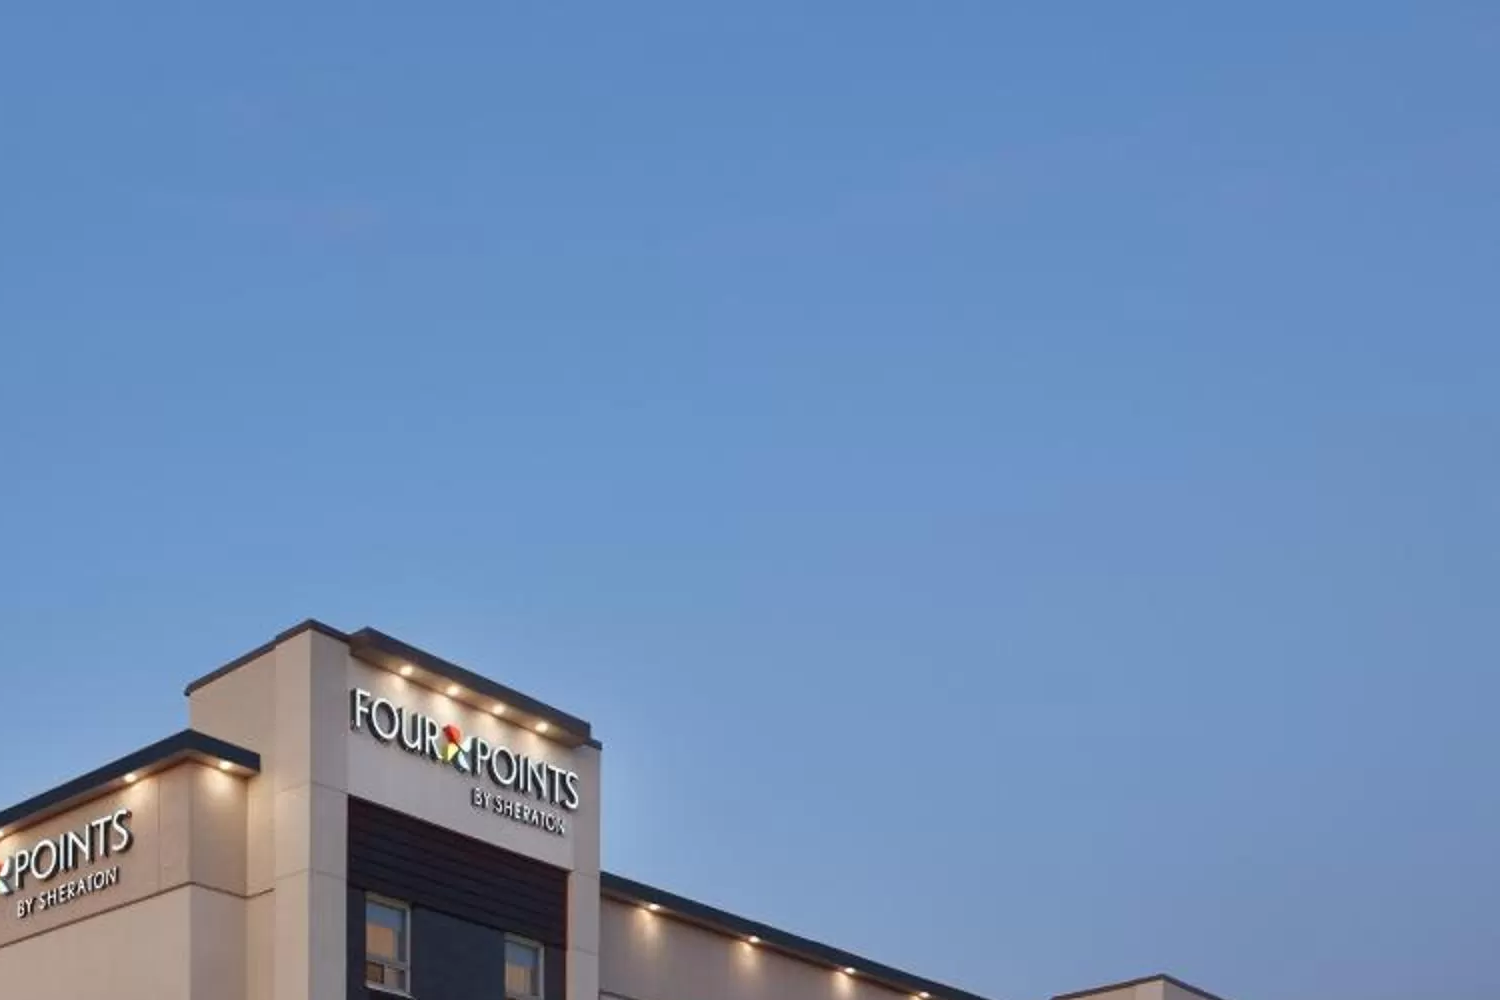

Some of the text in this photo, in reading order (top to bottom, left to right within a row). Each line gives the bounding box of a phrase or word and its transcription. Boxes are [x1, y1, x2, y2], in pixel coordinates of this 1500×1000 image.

[352, 687, 580, 810] FOUR POINTS
[472, 786, 566, 836] BY SHERATON
[14, 808, 130, 889] POINTS
[16, 866, 120, 918] BY SHERATON
